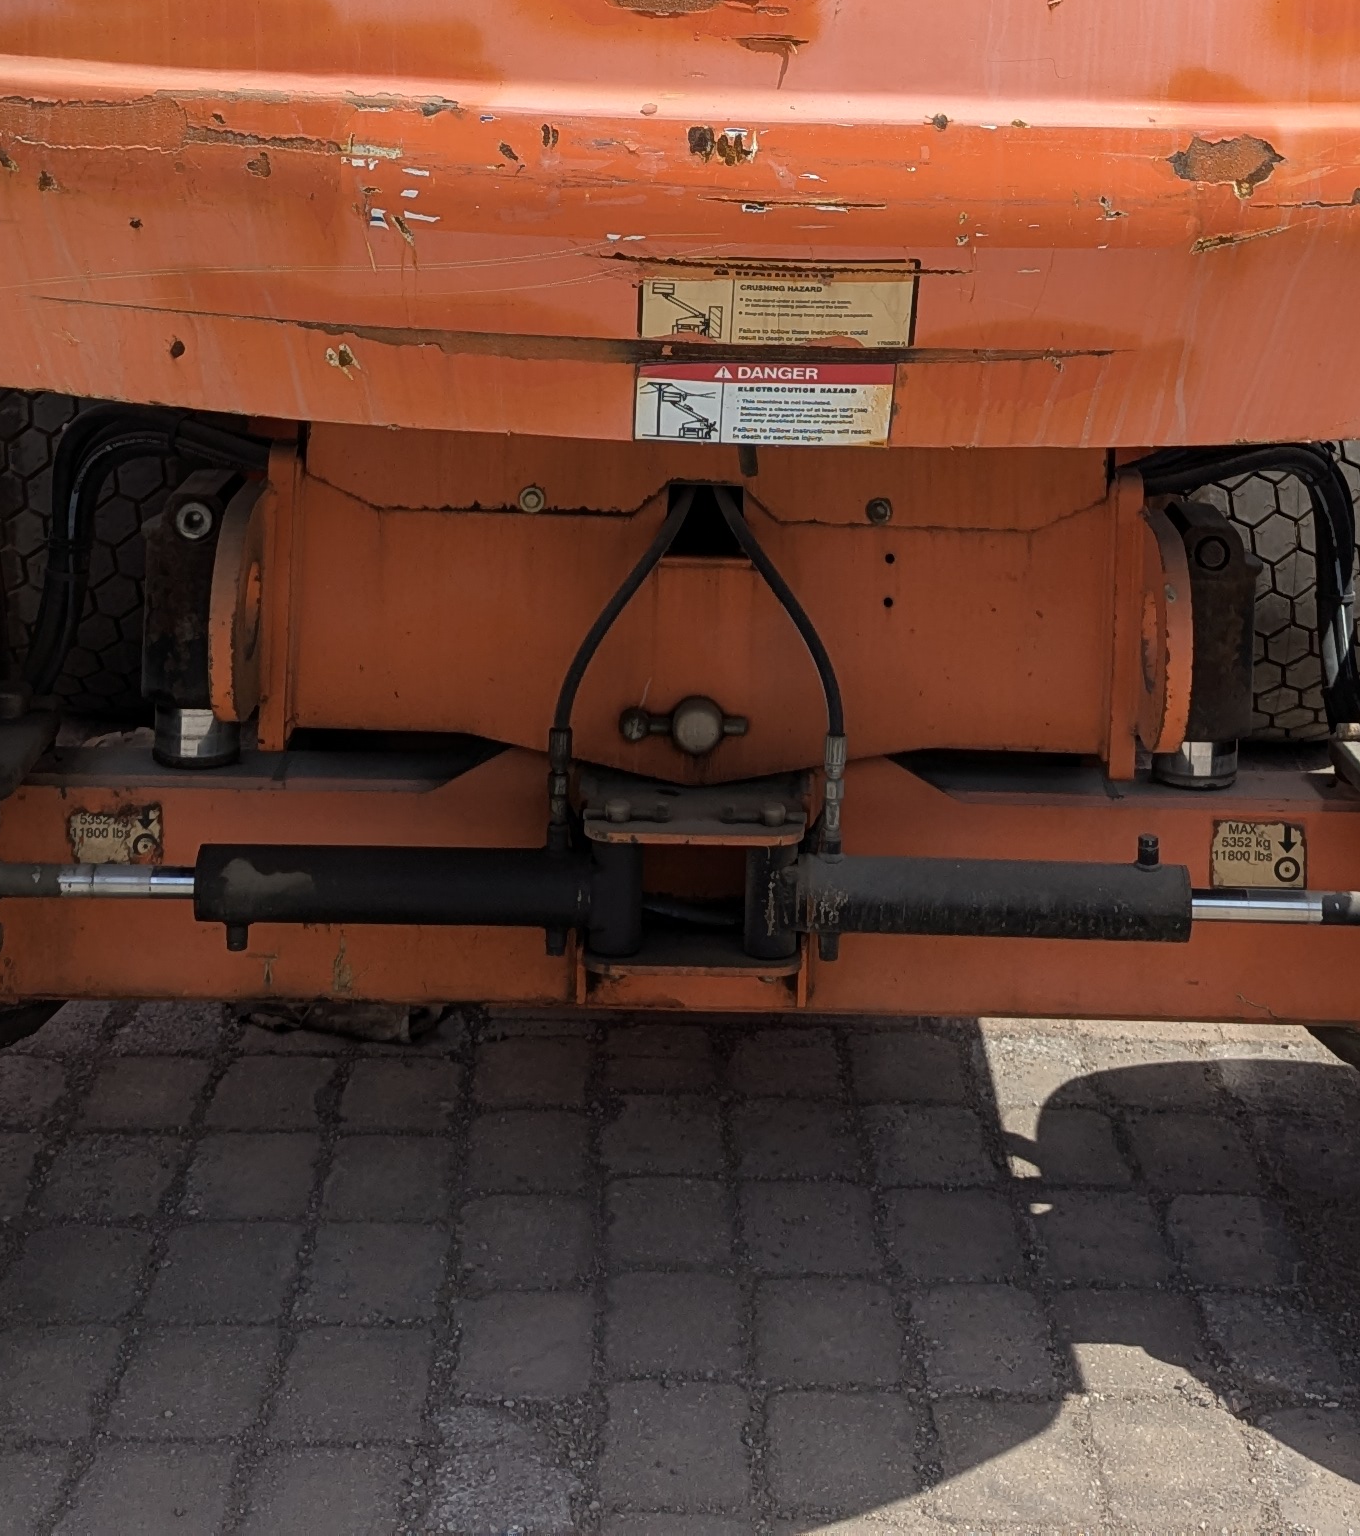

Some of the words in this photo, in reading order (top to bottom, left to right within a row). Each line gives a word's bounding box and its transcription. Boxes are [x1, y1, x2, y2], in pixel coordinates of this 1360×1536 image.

[740, 284, 786, 292] CRUSHING
[787, 285, 823, 293] HAZARD
[737, 366, 818, 380] DANGER
[738, 386, 816, 394] ELECTROCUTION
[72, 827, 109, 839] 11800
[112, 827, 131, 839] lbs
[1228, 824, 1257, 835] MAX
[1221, 836, 1252, 848] 5352
[1255, 837, 1271, 850] kg
[1213, 850, 1251, 861] 11800
[1254, 850, 1273, 862] lbs
